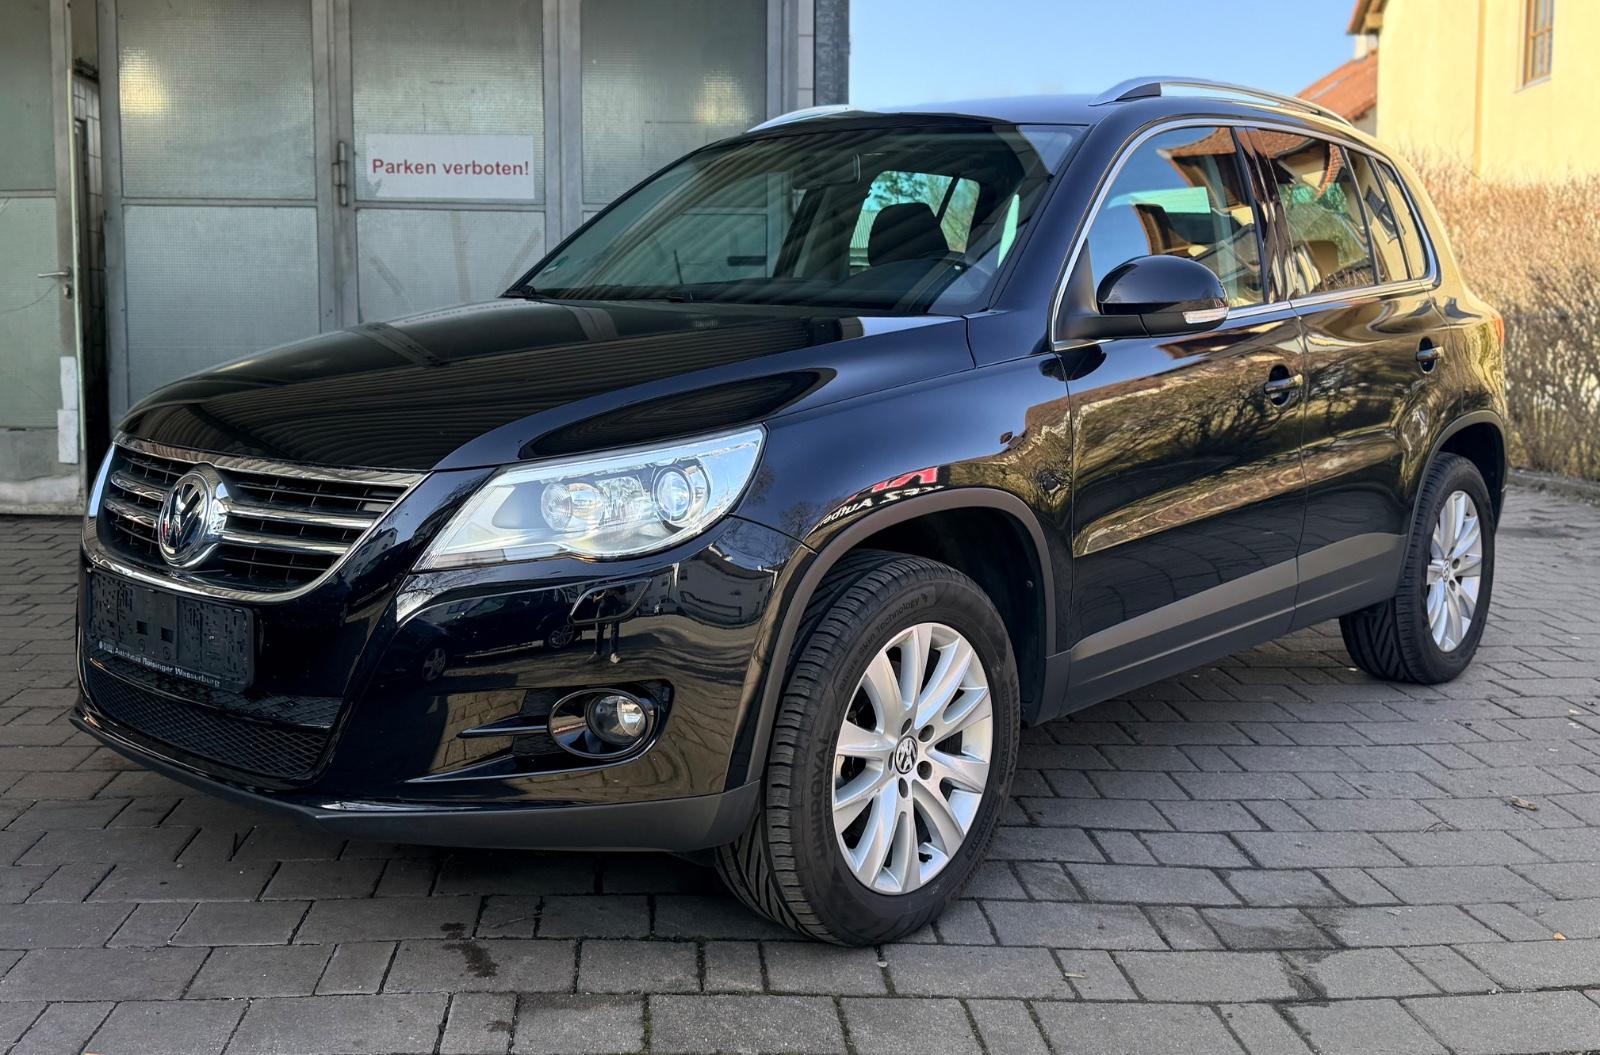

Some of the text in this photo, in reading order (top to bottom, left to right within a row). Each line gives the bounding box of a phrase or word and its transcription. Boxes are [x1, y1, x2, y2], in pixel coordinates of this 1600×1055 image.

[371, 158, 529, 176] Parken verboten!
[811, 731, 830, 860] UNIROYAL
